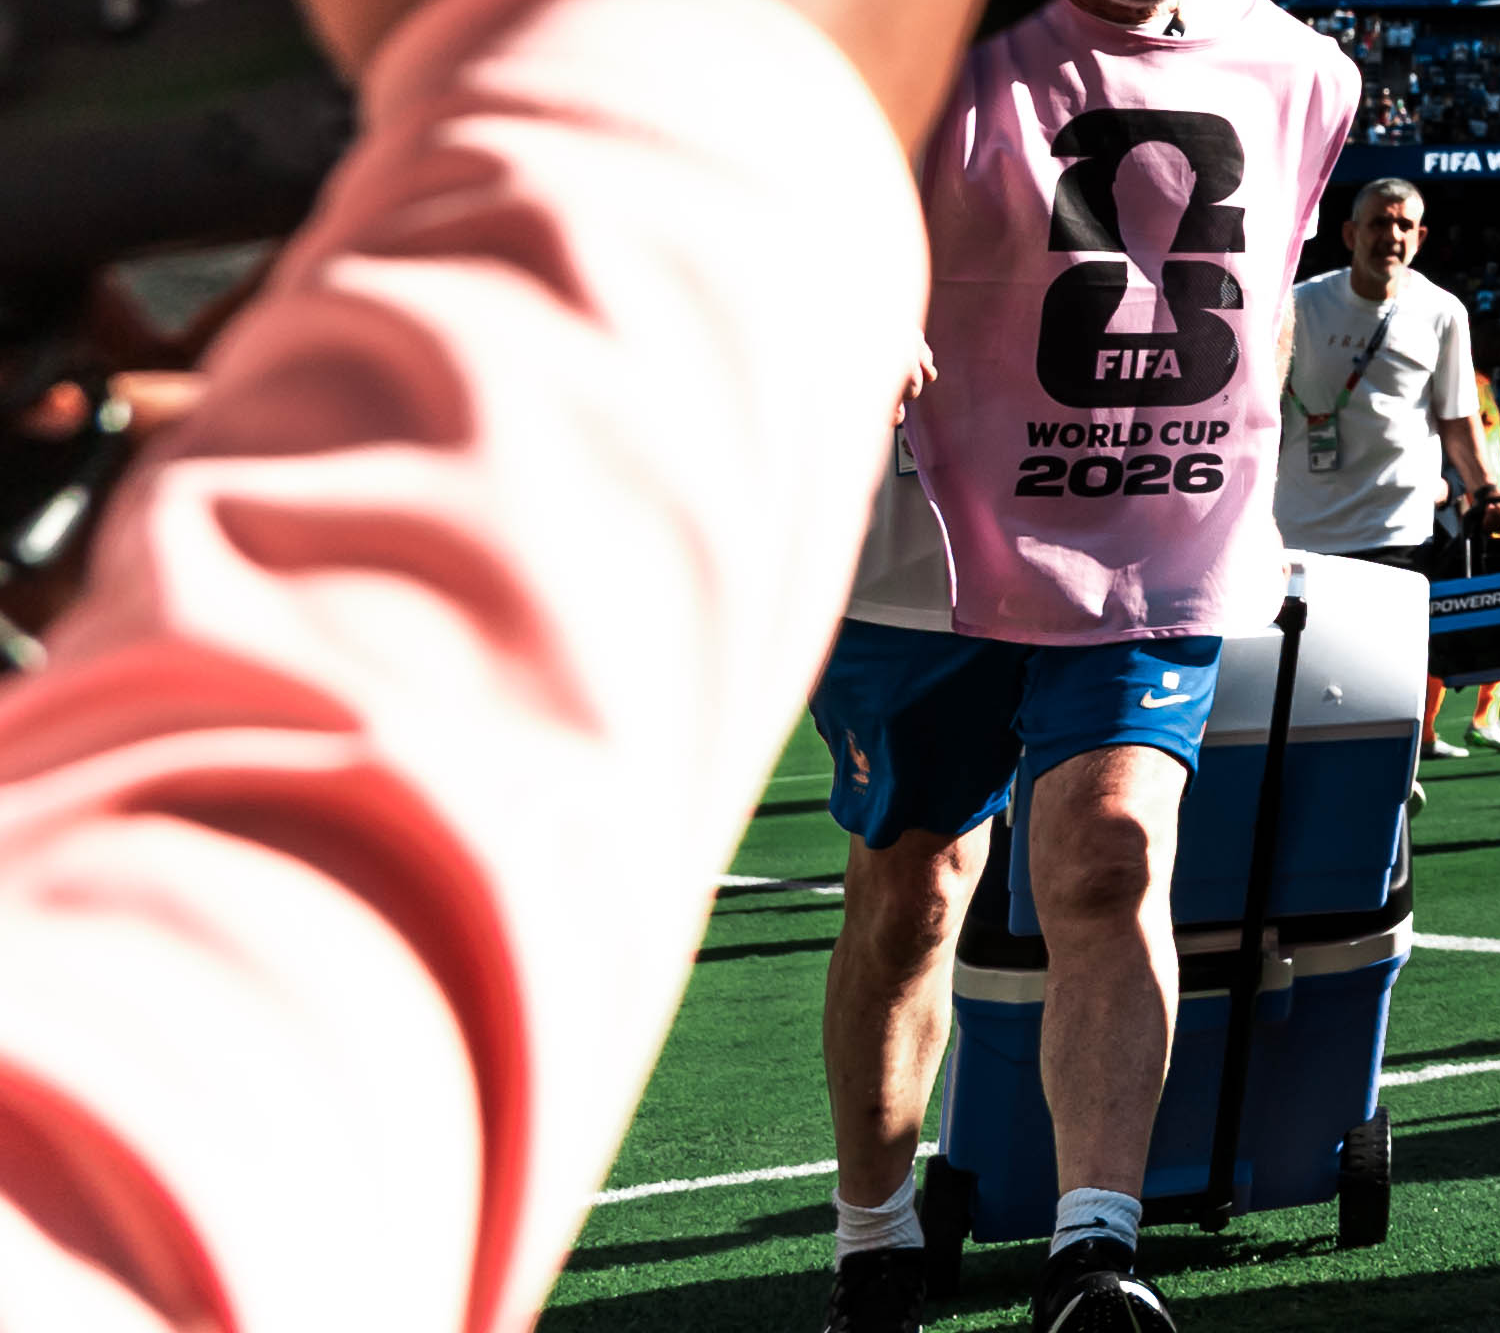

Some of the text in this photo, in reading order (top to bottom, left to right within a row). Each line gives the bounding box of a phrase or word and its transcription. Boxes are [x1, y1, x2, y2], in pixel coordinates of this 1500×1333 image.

[1424, 151, 1482, 172] FIFA
[1094, 349, 1182, 380] FIFA
[1026, 420, 1230, 448] WORLD CUP
[1014, 453, 1224, 498] 2026
